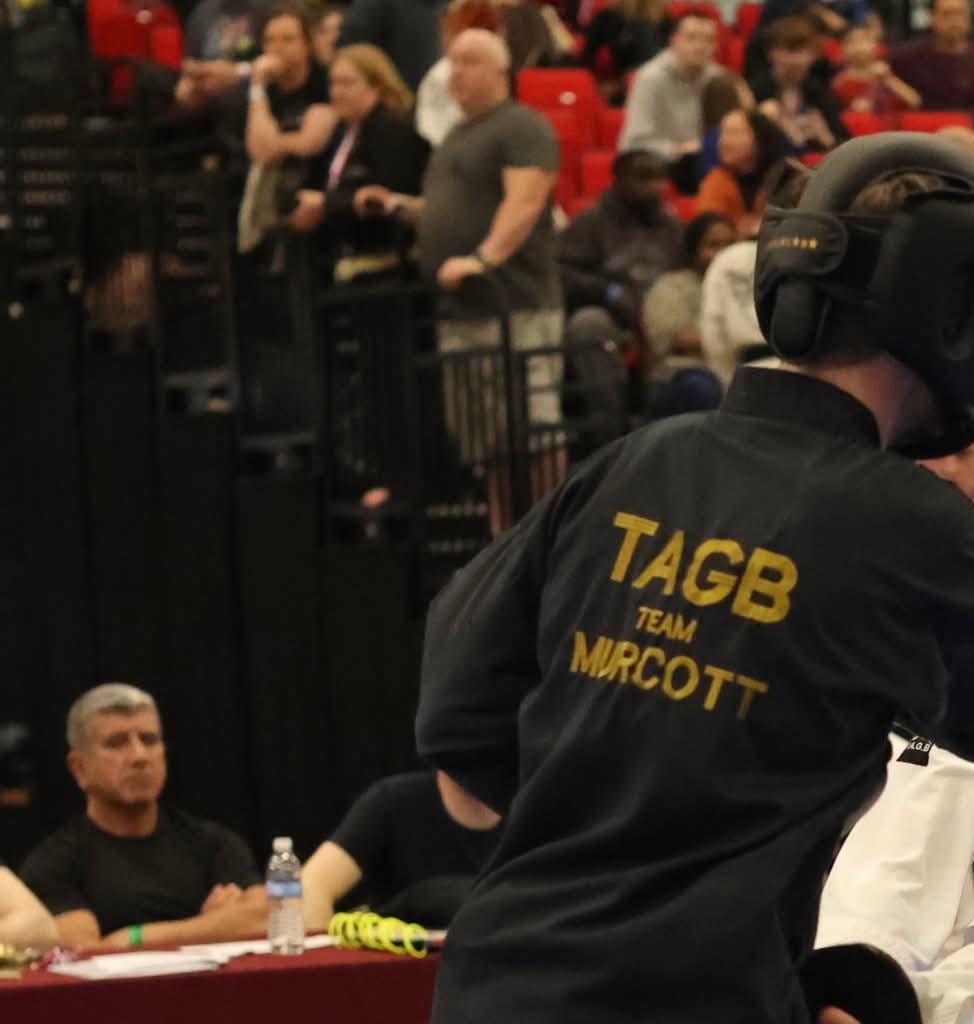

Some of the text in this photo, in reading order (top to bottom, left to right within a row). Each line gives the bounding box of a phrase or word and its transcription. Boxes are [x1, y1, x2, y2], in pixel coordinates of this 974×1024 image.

[610, 511, 798, 624] TAGB
[635, 606, 698, 643] TEAM
[569, 631, 769, 721] MURCOTT
